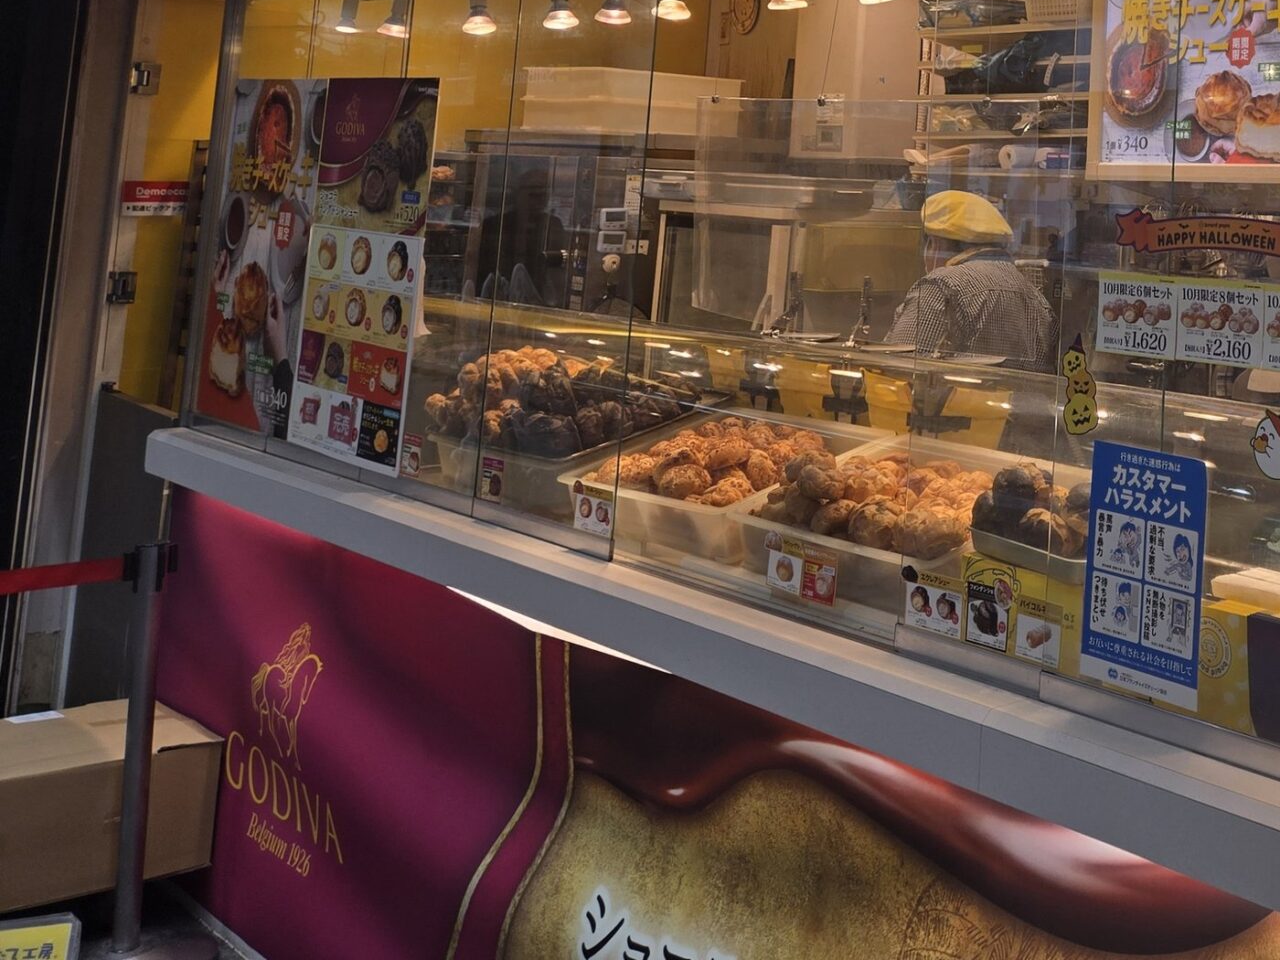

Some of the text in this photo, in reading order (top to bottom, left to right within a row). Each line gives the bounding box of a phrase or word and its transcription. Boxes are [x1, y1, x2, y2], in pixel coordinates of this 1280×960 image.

[1168, 33, 1229, 65] シュー
[335, 120, 366, 136] GODIVA
[1117, 135, 1148, 151] ¥340
[136, 186, 188, 196] Demaeca
[1157, 231, 1276, 251] HAPPY HALLOWEEN
[1103, 282, 1173, 300] 10月限定6個セット
[1182, 287, 1259, 306] 10月限定8個セット
[1124, 331, 1167, 352] ¥1,620
[1206, 339, 1251, 360] ¥2,160
[1120, 451, 1181, 473] 行き過ぎた迷惑行為は
[1112, 464, 1187, 494] カスタマー
[1104, 487, 1192, 523] ハラスメント
[1092, 575, 1101, 623] つきまとい
[1100, 576, 1108, 617] 待ち伏せ
[1088, 636, 1193, 676] お互いに尊重される社会を目指して
[226, 730, 343, 864] GODIVA
[246, 812, 312, 877] Belgium 1926
[0, 942, 55, 960] て工房
